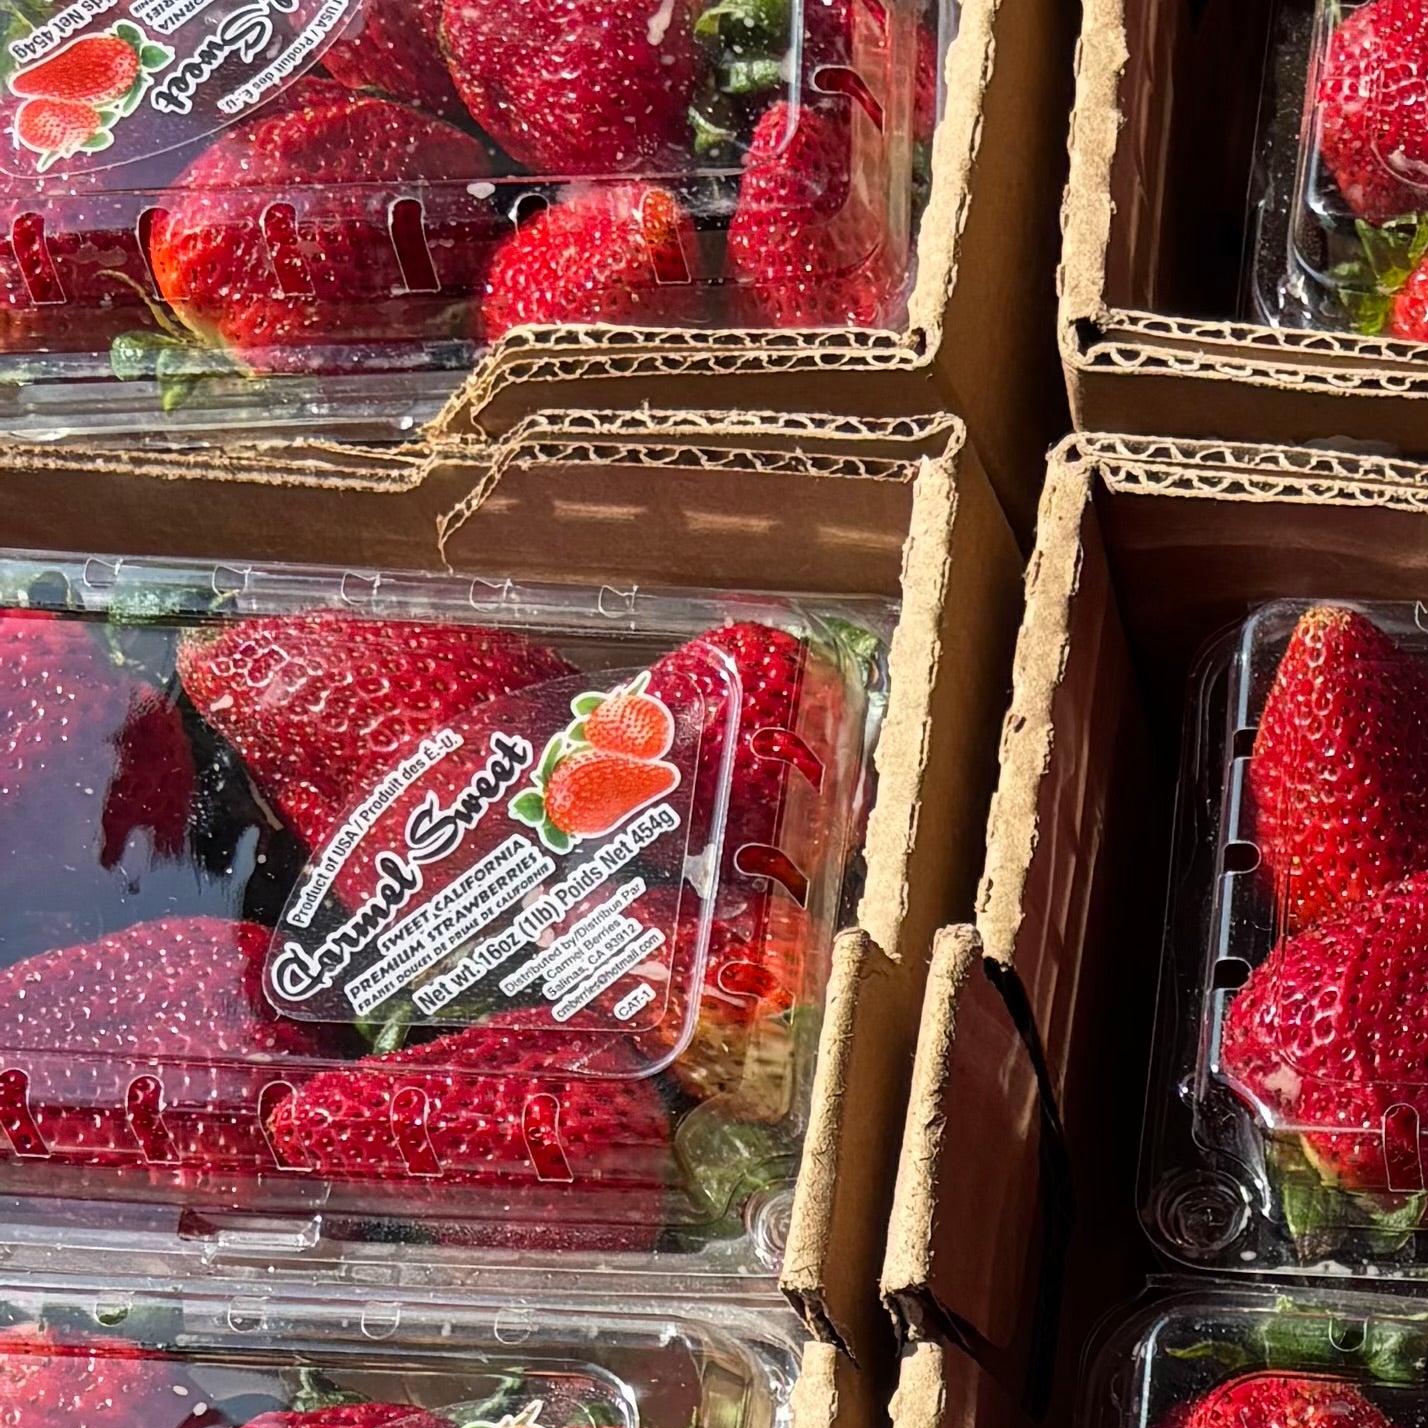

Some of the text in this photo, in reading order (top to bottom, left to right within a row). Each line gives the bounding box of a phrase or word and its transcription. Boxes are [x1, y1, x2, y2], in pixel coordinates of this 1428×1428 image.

[11, 29, 55, 60] 454g
[156, 9, 268, 111] Sweet
[277, 737, 528, 997] Carmel Sweet
[381, 838, 526, 953] SWEET CALIFORNIA
[349, 851, 538, 1002] PREMIUM STRAWBERRIES
